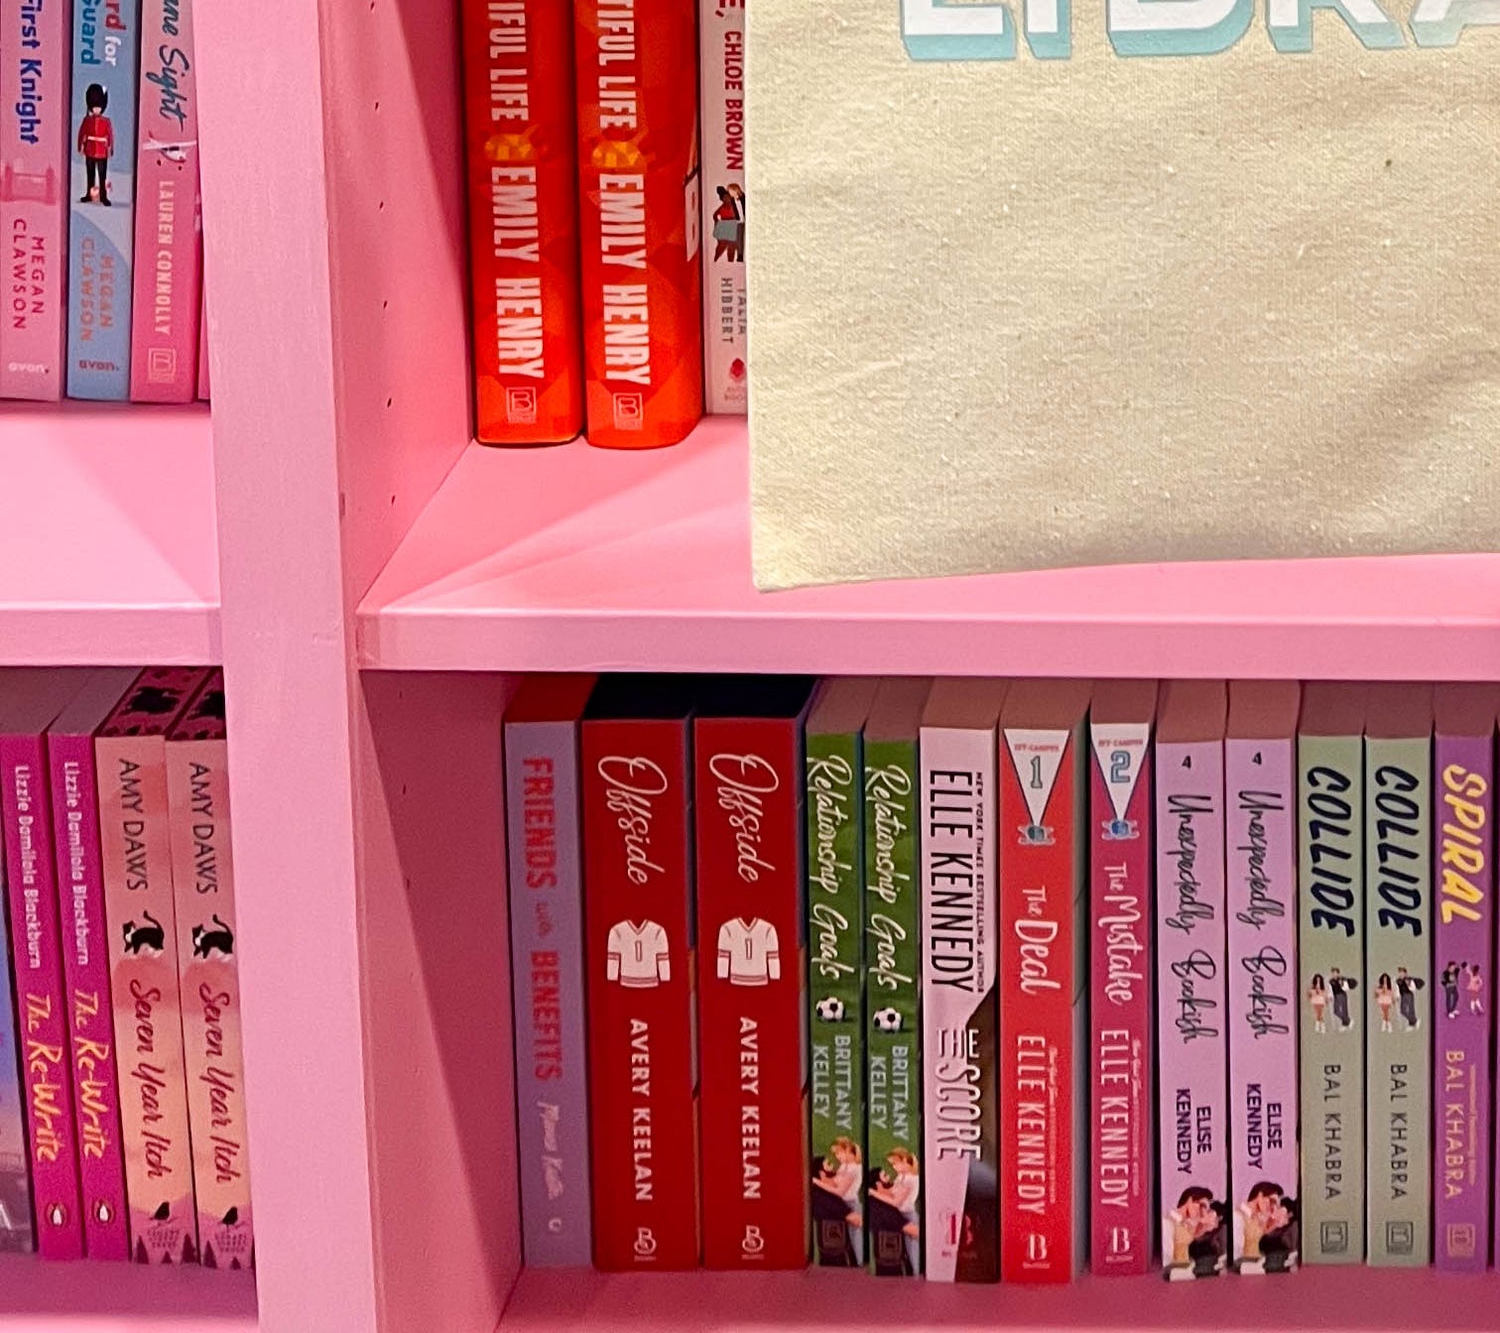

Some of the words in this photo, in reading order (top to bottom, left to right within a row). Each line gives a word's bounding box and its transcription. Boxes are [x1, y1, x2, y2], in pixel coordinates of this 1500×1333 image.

[105, 36, 117, 66] for
[723, 31, 744, 90] CHLOE
[13, 58, 43, 145] Knight
[489, 69, 529, 121] LIFE
[726, 100, 744, 171] BROWN
[491, 166, 538, 263] EMILY
[11, 218, 26, 330] CLAWSON
[31, 237, 45, 313] MEGAN
[495, 277, 545, 379] HENRY
[119, 758, 144, 813] AMY
[598, 755, 668, 885] Offside
[929, 769, 974, 838] ELLE
[123, 817, 148, 891] DAWS
[1307, 765, 1355, 938] COLLIDE
[1441, 763, 1488, 924] SPIRAL
[930, 851, 974, 993] KENNEDY
[630, 1018, 650, 1098] AVERY
[812, 1044, 830, 1118] KELLEY
[835, 1035, 852, 1131] BRITTANY
[1017, 1035, 1045, 1094] ELLE
[1324, 1064, 1341, 1105] BAL
[634, 1108, 653, 1201] KEELAN
[934, 1063, 984, 1162] SCORE
[1176, 1089, 1192, 1175] KENNEDY
[1196, 1106, 1212, 1154] ELISE
[1017, 1102, 1047, 1216] KENNEDY
[1323, 1114, 1341, 1202] KHABRA
